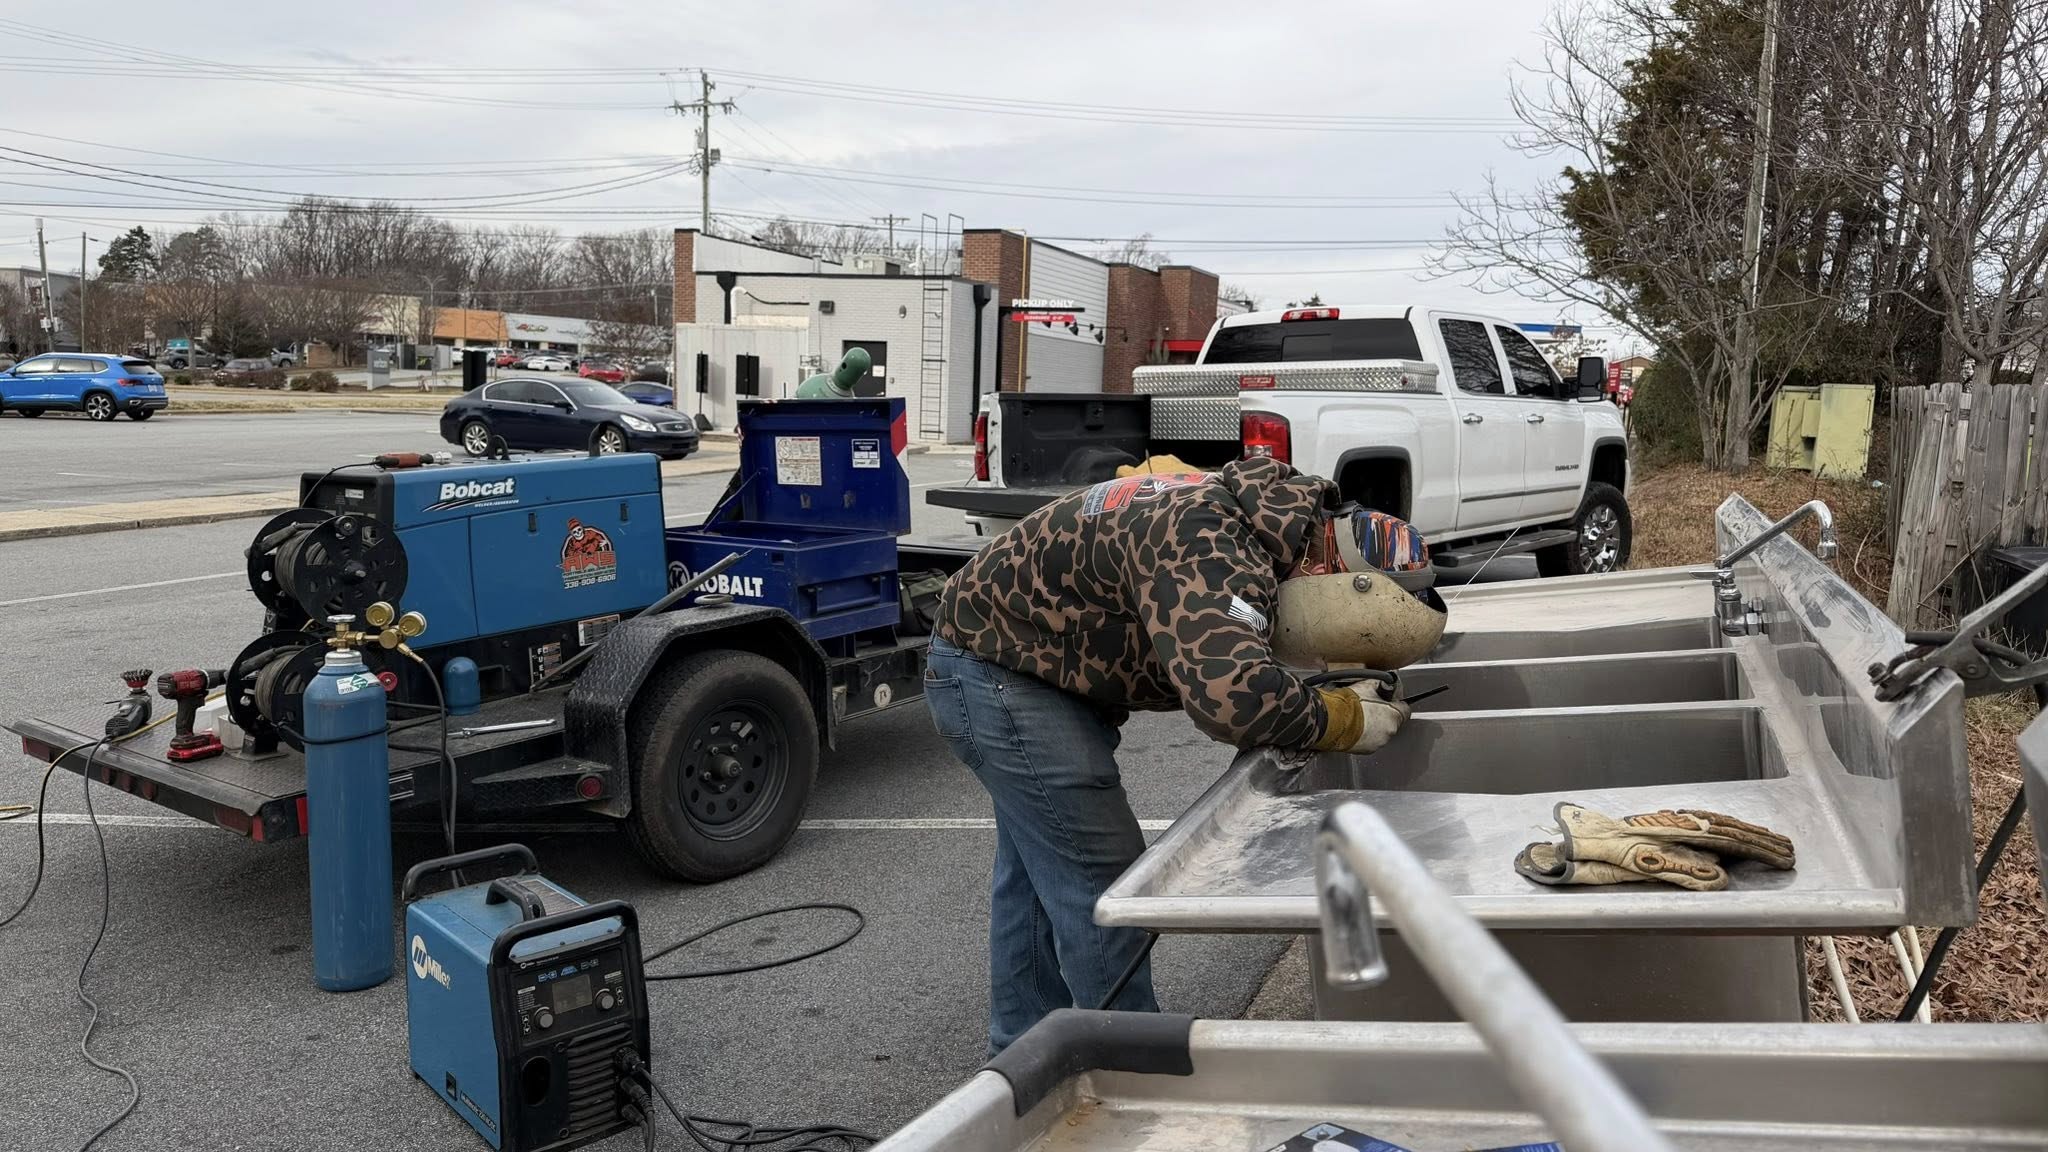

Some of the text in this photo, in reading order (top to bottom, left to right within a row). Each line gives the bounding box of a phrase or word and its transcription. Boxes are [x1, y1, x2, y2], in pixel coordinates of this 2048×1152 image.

[1012, 298, 1075, 308] PICKUP ONLY
[440, 477, 515, 501] Bobcat
[563, 549, 616, 574] AWS
